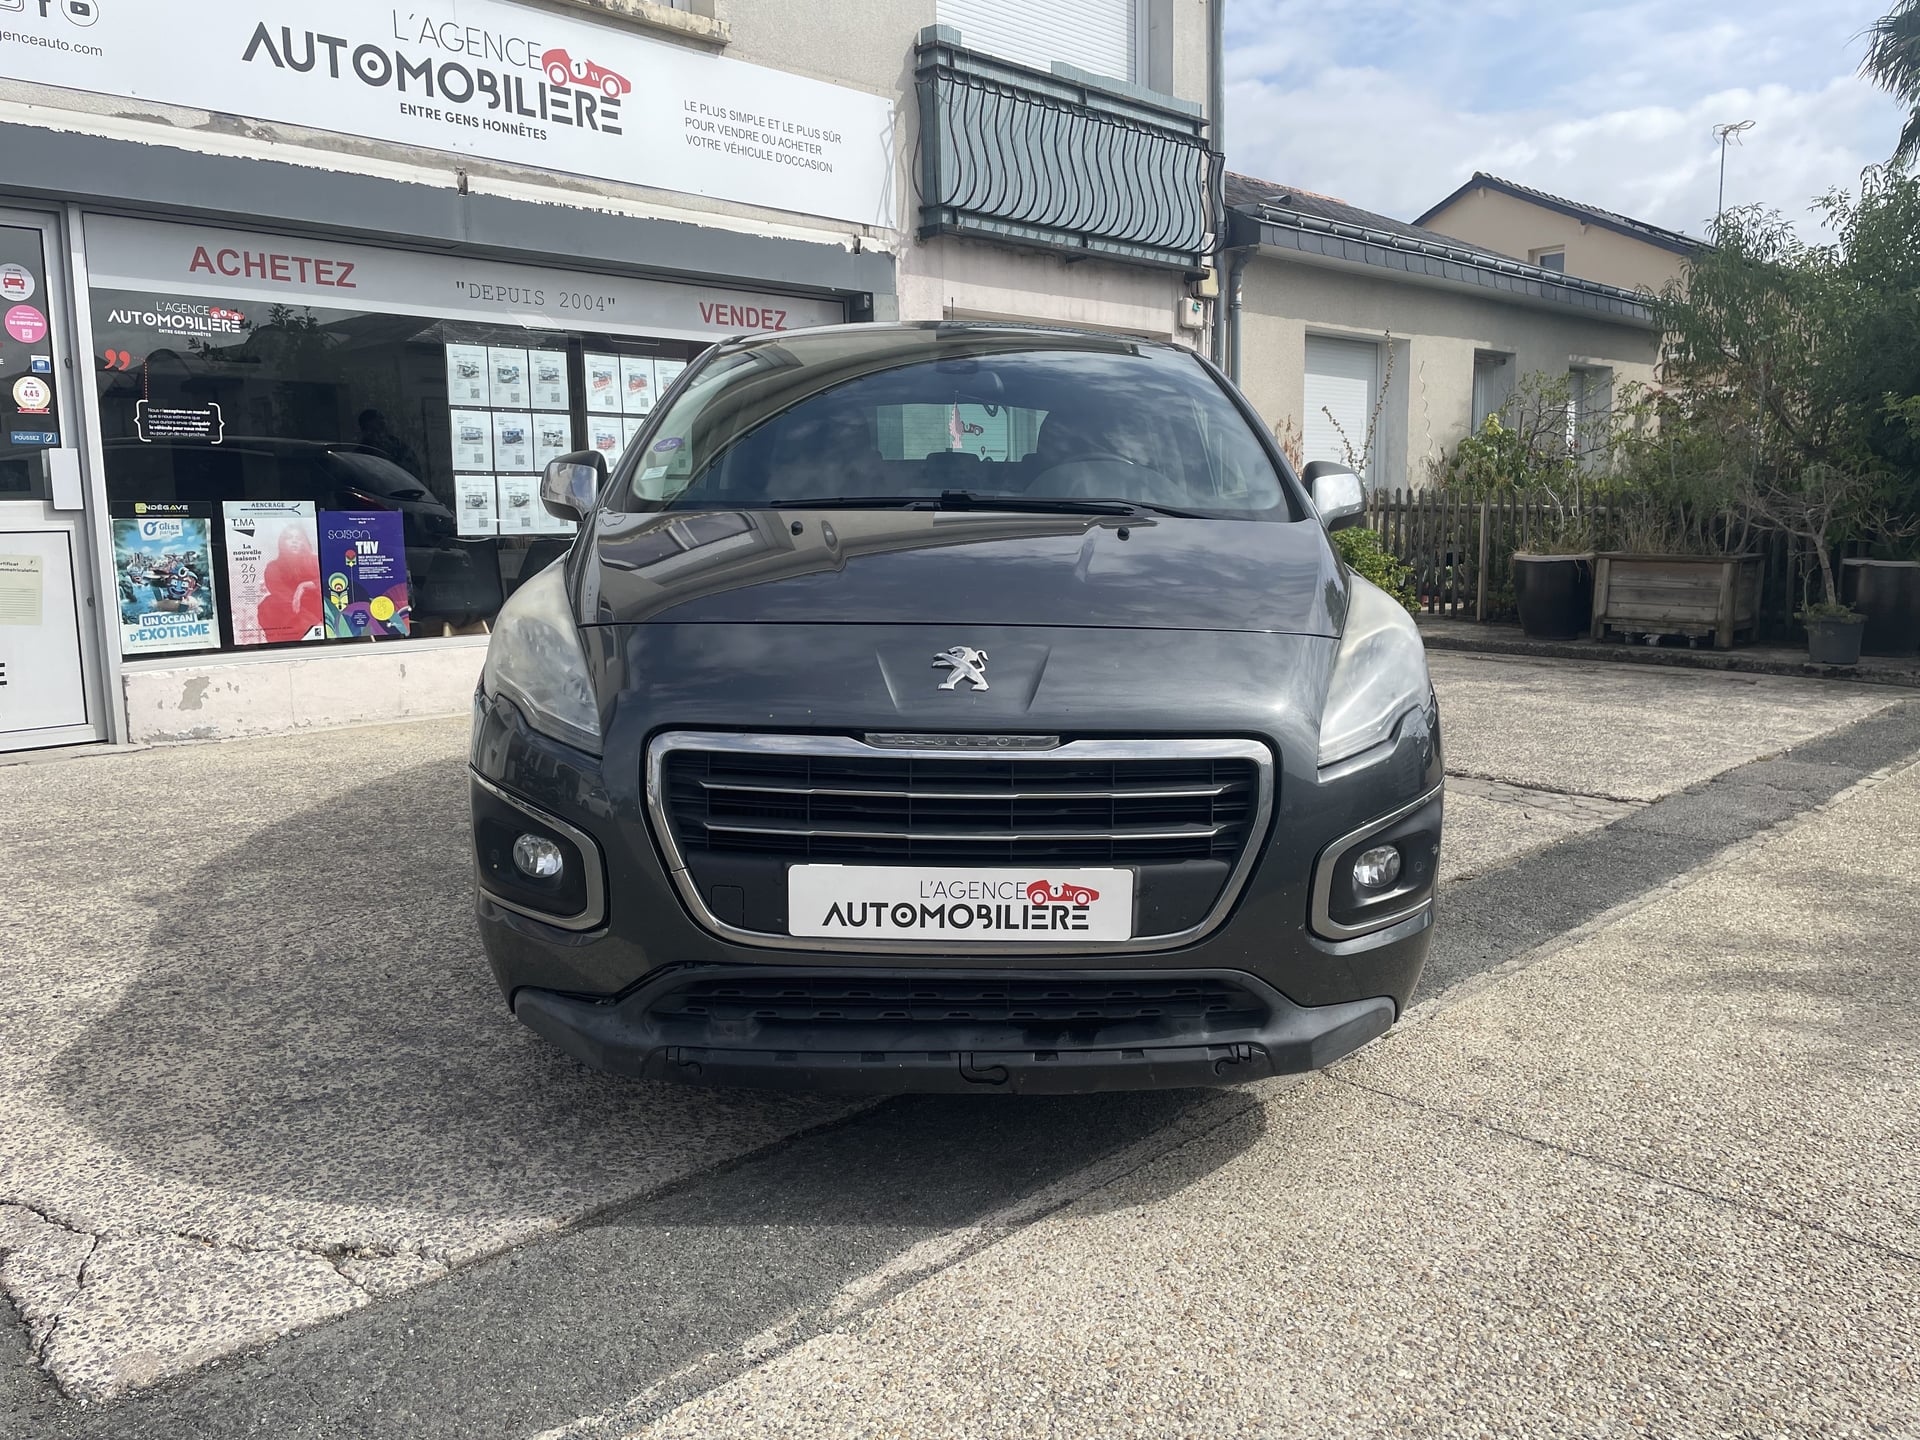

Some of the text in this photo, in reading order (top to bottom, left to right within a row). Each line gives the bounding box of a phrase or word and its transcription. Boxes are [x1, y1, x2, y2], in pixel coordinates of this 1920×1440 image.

[0, 30, 102, 56] enceauto.com
[393, 9, 542, 71] L'AGENCE
[400, 102, 547, 140] ENTRE GENS HONNÊTES
[684, 100, 842, 144] LE PLUS SIMPLE ET LE PLUS SÛR
[685, 117, 822, 155] POUR VENDRE OU ACHETER
[686, 134, 832, 173] VOTRE VÉHICULE D'OCCASION
[189, 246, 356, 288] ACHETEZ
[156, 301, 210, 316] L'AGENCE
[456, 281, 615, 311] "DEPUIS 2004"
[699, 302, 787, 331] VENDEZ
[241, 563, 256, 573] 26
[242, 574, 256, 583] 27
[130, 624, 209, 642] D'EXOTISME
[920, 880, 1027, 900] L'AGENCE
